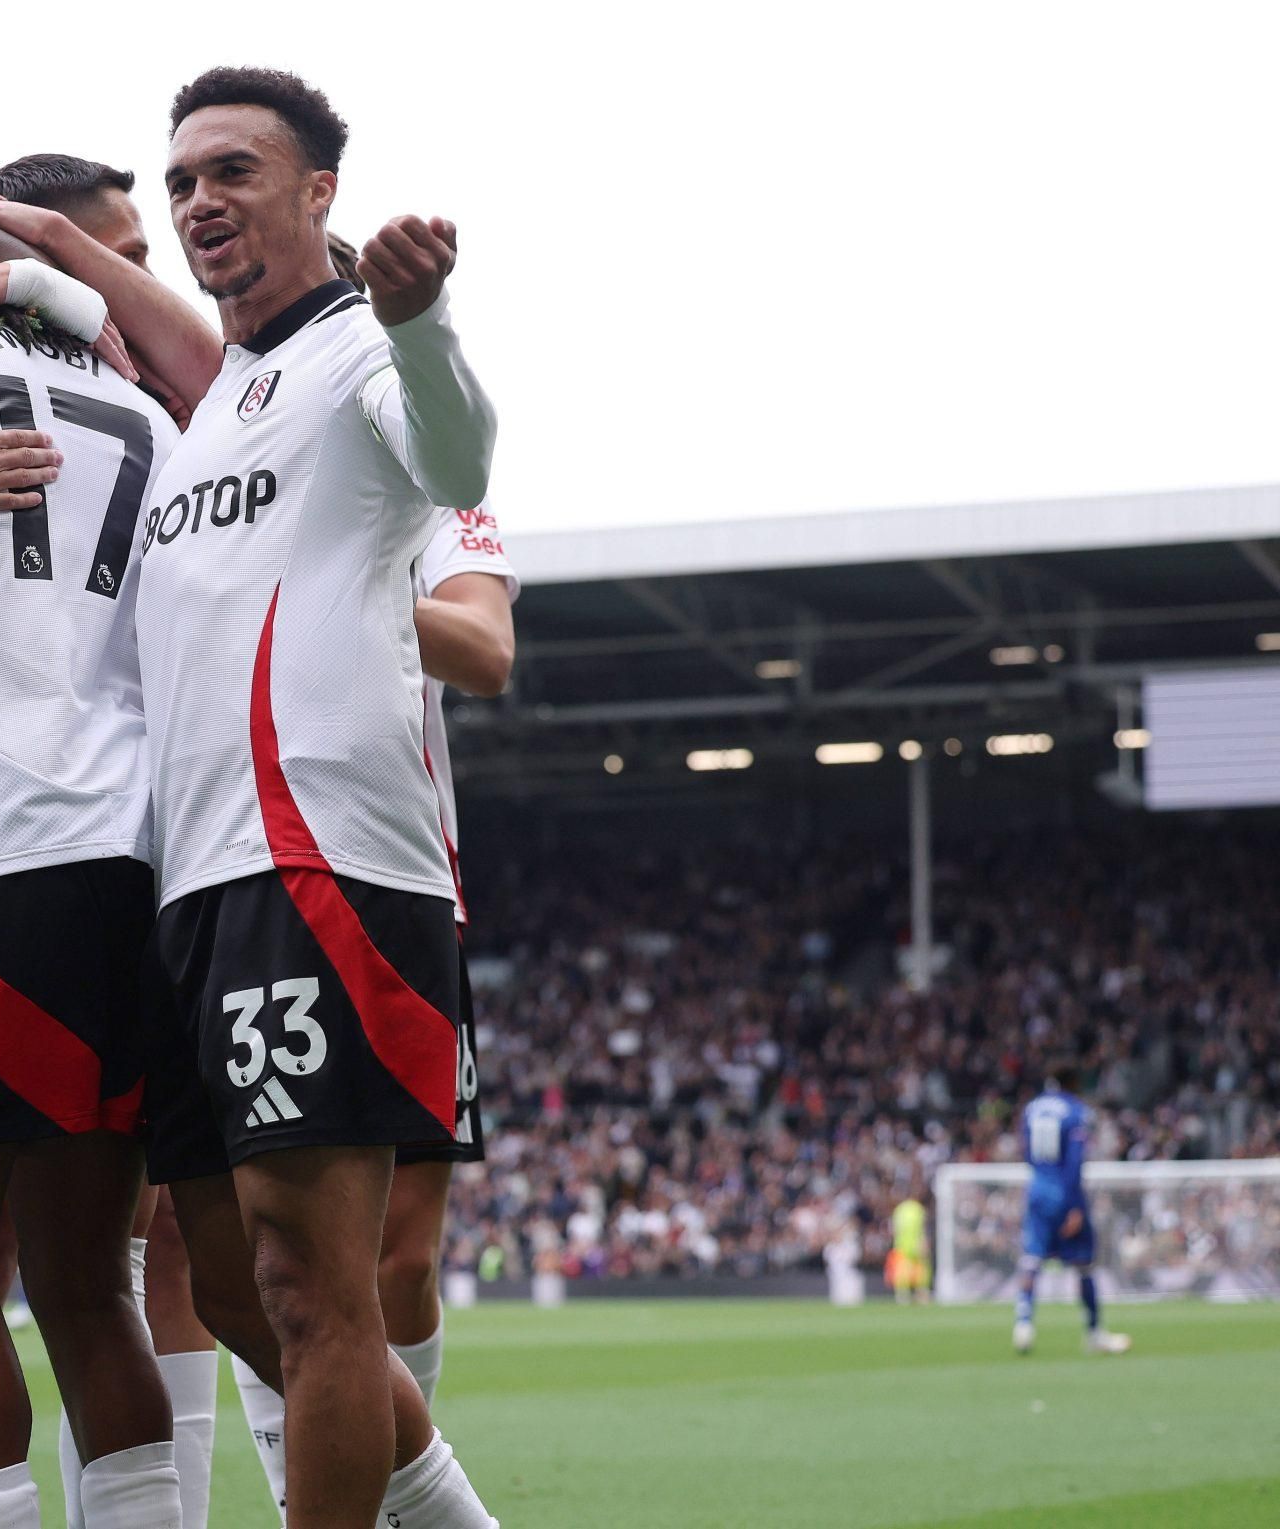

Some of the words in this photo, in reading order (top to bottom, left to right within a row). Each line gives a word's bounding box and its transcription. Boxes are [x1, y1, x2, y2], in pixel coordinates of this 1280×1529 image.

[142, 469, 277, 557] BOTOP
[222, 977, 328, 1088] 33
[254, 1430, 280, 1449] FF
